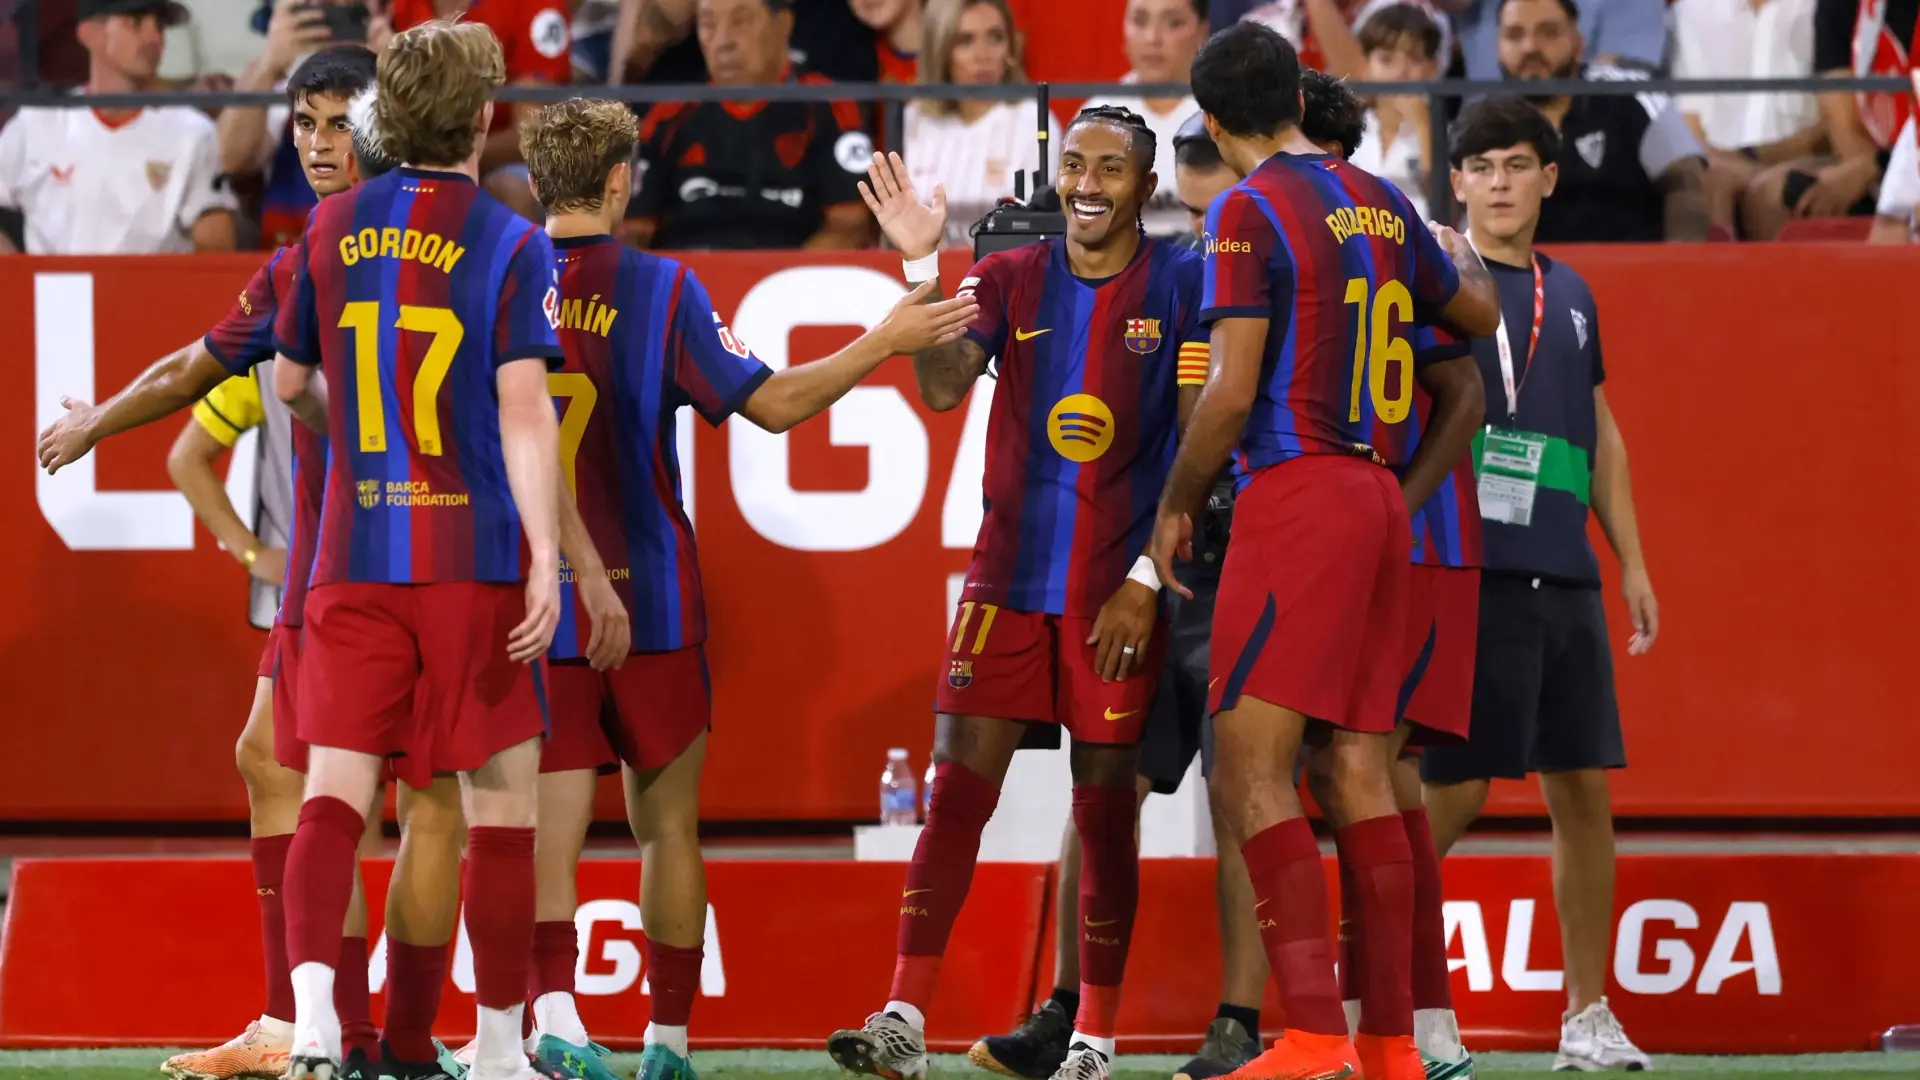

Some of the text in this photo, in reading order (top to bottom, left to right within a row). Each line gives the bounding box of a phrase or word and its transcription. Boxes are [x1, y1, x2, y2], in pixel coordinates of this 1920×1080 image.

[339, 227, 465, 274] GORDON
[560, 294, 618, 338] MÍN
[1343, 277, 1414, 424] 16
[337, 301, 464, 456] 17
[386, 482, 429, 495] BARÇA
[386, 494, 468, 506] FOUNDATION
[952, 601, 998, 654] 11
